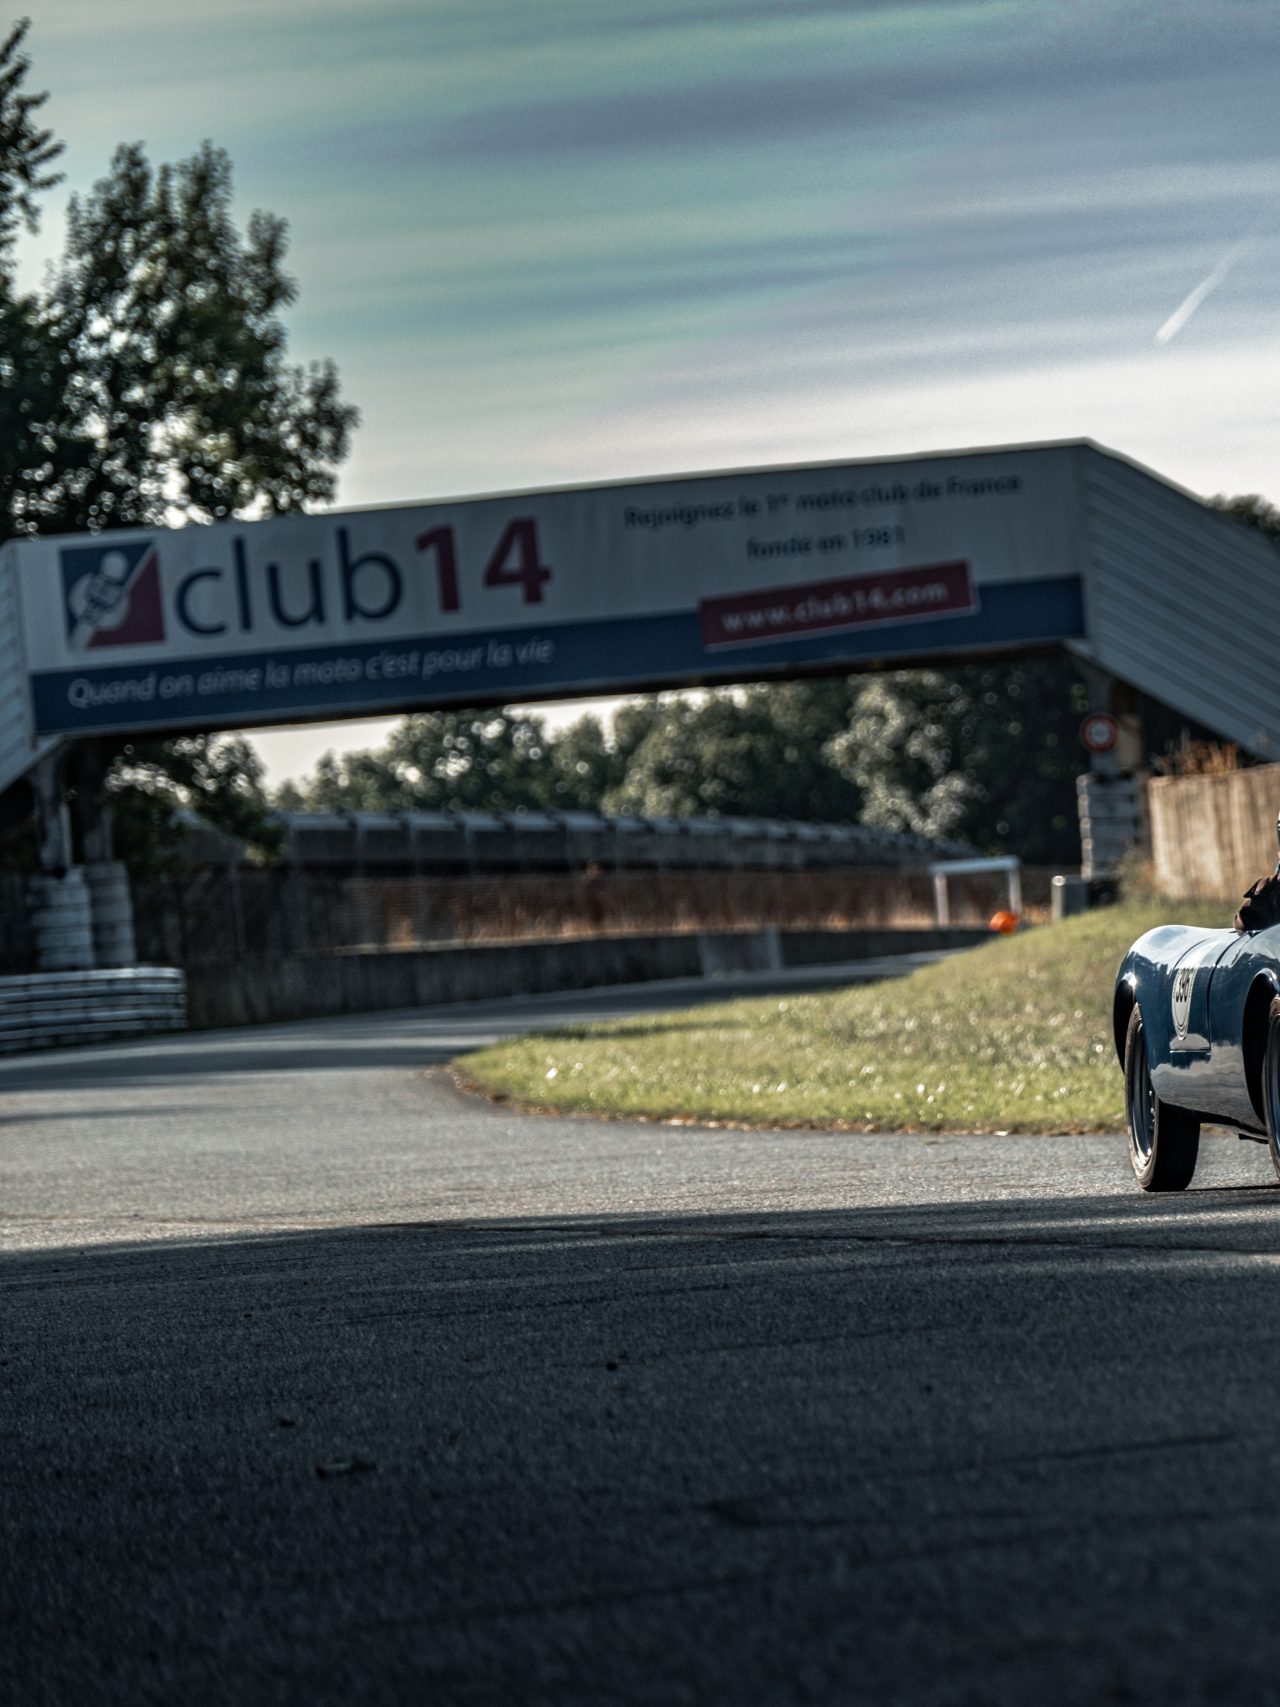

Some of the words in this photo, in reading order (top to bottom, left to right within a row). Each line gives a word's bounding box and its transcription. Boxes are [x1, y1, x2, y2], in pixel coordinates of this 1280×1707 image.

[624, 501, 734, 532] Rejoignez
[740, 494, 758, 518] le
[795, 489, 857, 513] moto
[860, 480, 911, 508] club
[913, 477, 938, 503] de
[940, 474, 1024, 499] France
[747, 531, 814, 562] fondé
[817, 534, 848, 556] en
[720, 581, 949, 633] www.club14.com
[68, 669, 158, 708] Quand
[159, 673, 194, 699] on
[197, 664, 263, 696] aime
[264, 659, 291, 689] la
[293, 656, 363, 687] moto
[365, 648, 421, 680] c'est
[422, 645, 485, 680] pour
[487, 638, 513, 669] la
[515, 635, 555, 666] vie
